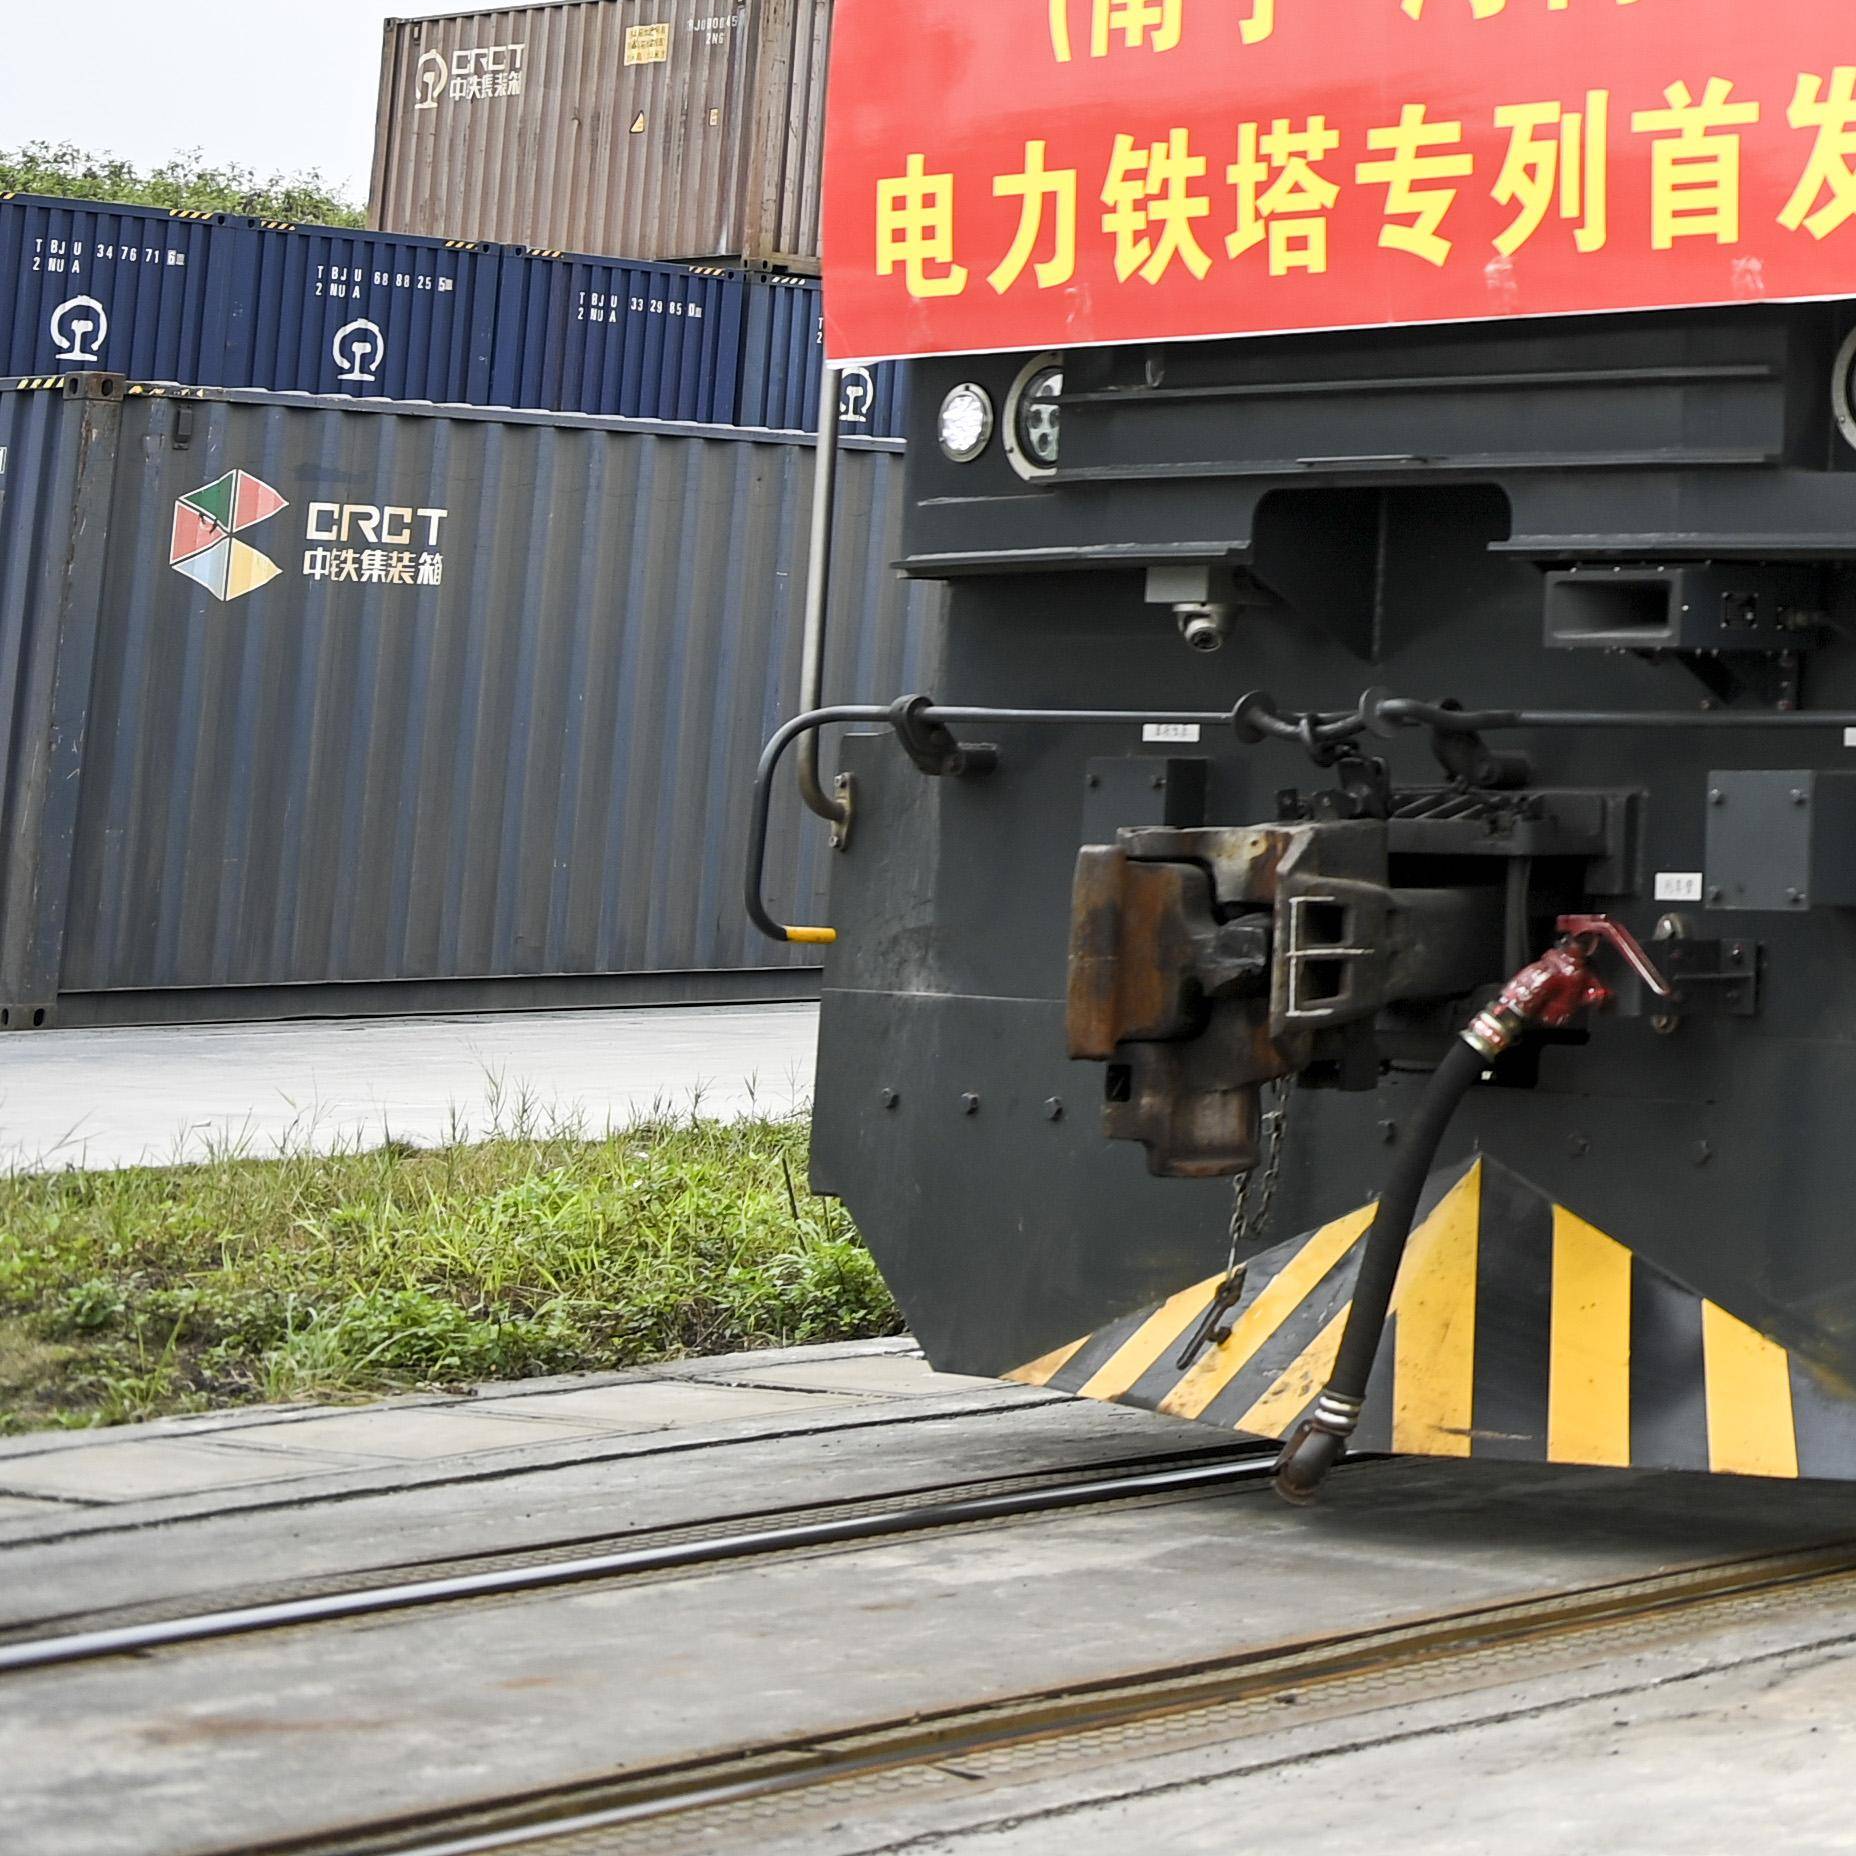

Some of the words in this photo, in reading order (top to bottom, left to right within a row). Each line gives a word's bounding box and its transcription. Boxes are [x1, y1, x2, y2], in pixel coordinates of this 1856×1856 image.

[452, 44, 526, 74] CRCT
[306, 501, 448, 546] CRCT
[303, 546, 444, 586] 中铁集装箱
